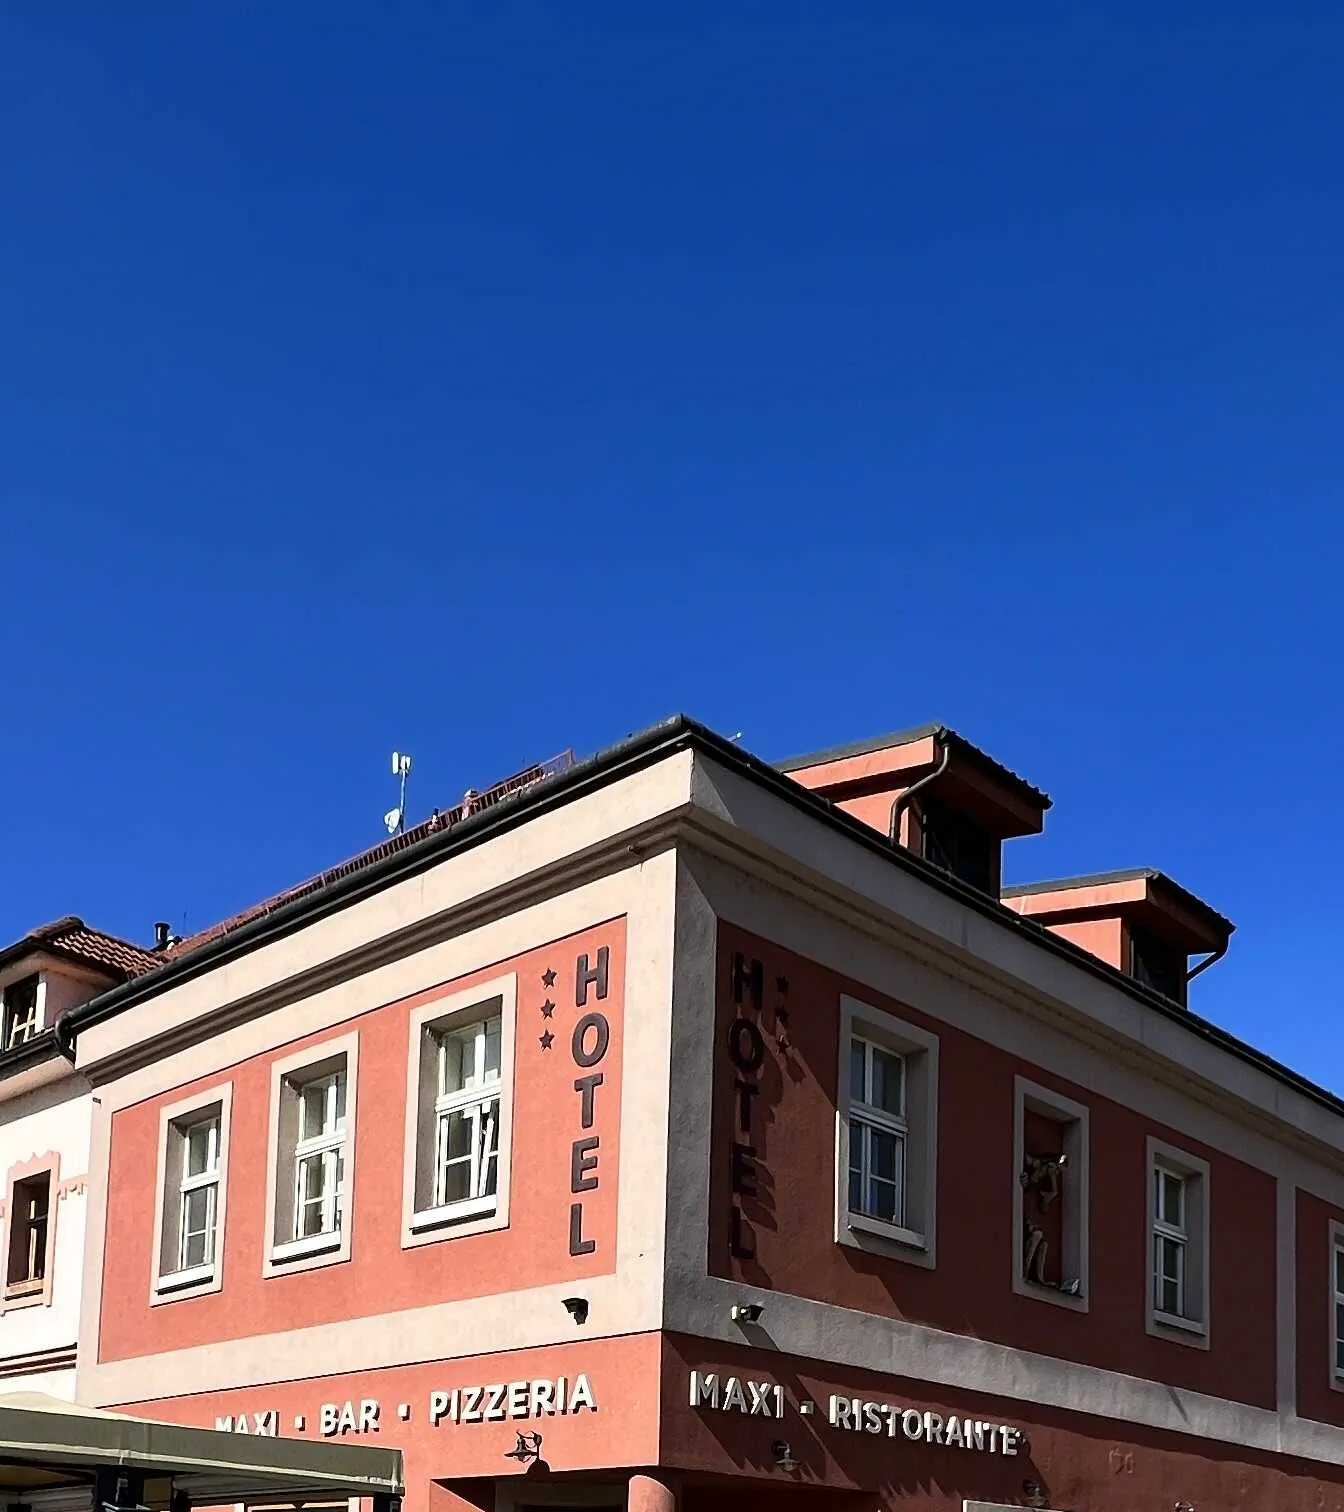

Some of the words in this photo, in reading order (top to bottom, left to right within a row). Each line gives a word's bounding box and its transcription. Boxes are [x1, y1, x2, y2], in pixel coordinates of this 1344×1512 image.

[569, 946, 610, 1257] HOTEL
[727, 951, 764, 1258] HOTEL
[215, 1409, 280, 1438] MAXI
[320, 1399, 379, 1437] BAR
[429, 1373, 596, 1426] PIZZERIA
[688, 1370, 785, 1419] MAXI
[828, 1394, 1022, 1456] RISTORANTE
